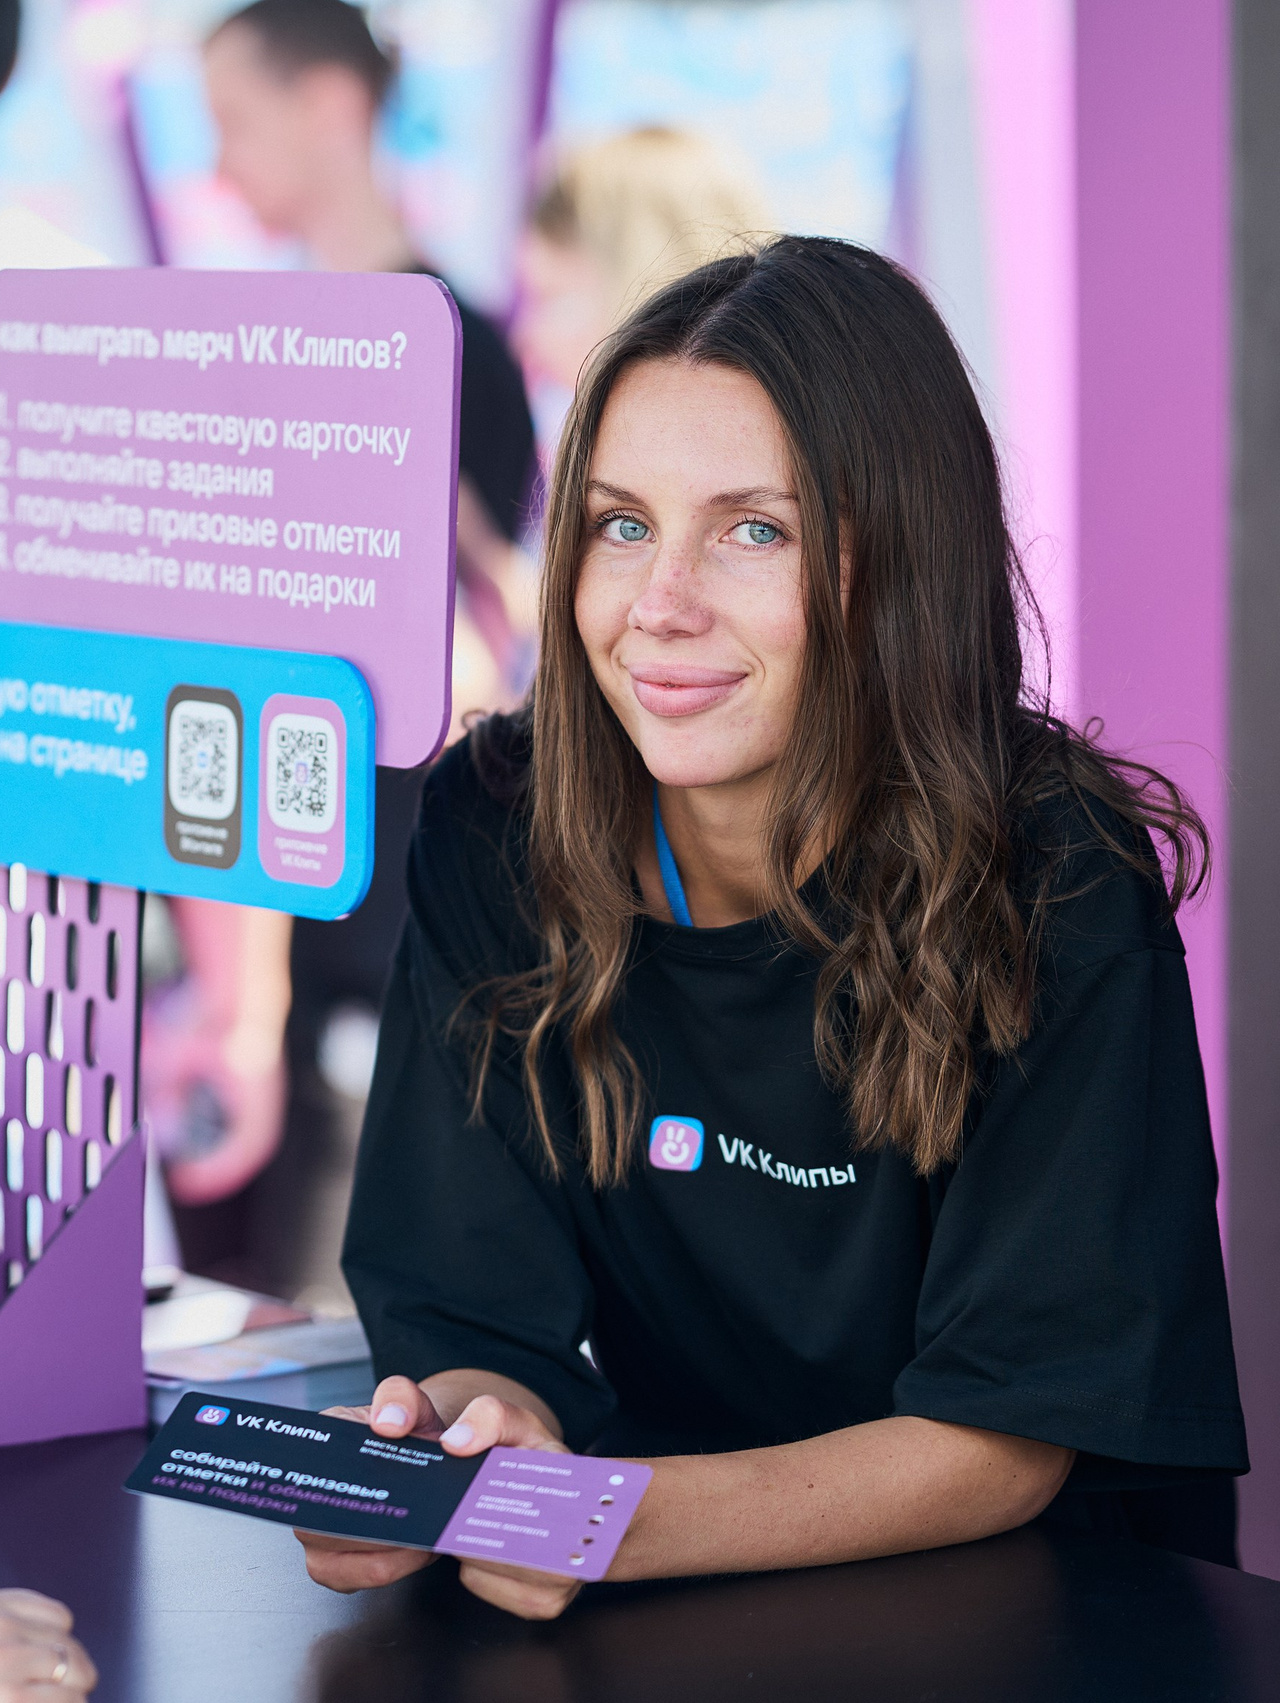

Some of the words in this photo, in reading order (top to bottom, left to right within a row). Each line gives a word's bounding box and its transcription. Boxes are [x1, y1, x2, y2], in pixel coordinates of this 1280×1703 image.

[41, 323, 159, 366] выиграть
[162, 327, 232, 371] мерч
[238, 324, 277, 365] VK
[283, 327, 407, 370] Клипов?
[18, 398, 133, 442] получите
[135, 409, 277, 455] квестовую
[283, 417, 410, 465] карточку
[16, 446, 164, 490] выполняйте
[167, 461, 273, 501] задания
[14, 492, 145, 539] получайте
[148, 505, 277, 548] призовые
[283, 519, 401, 559] отметки
[14, 536, 178, 589] обменивайте
[184, 558, 215, 592] их
[220, 565, 252, 595] на
[257, 565, 376, 613] подарки
[30, 682, 136, 734] отметку,
[30, 734, 148, 785] странице
[717, 1133, 758, 1170] VK
[758, 1148, 856, 1188] Клипы
[236, 1413, 264, 1430] VK
[265, 1419, 331, 1443] Клипы
[151, 1474, 178, 1489] их
[178, 1480, 206, 1494] на
[207, 1485, 299, 1515] подарки
[160, 1462, 249, 1488] отметки
[250, 1479, 266, 1491] и
[267, 1482, 409, 1519] обменивайте
[170, 1448, 283, 1479] собирайте
[284, 1470, 389, 1501] призовые
